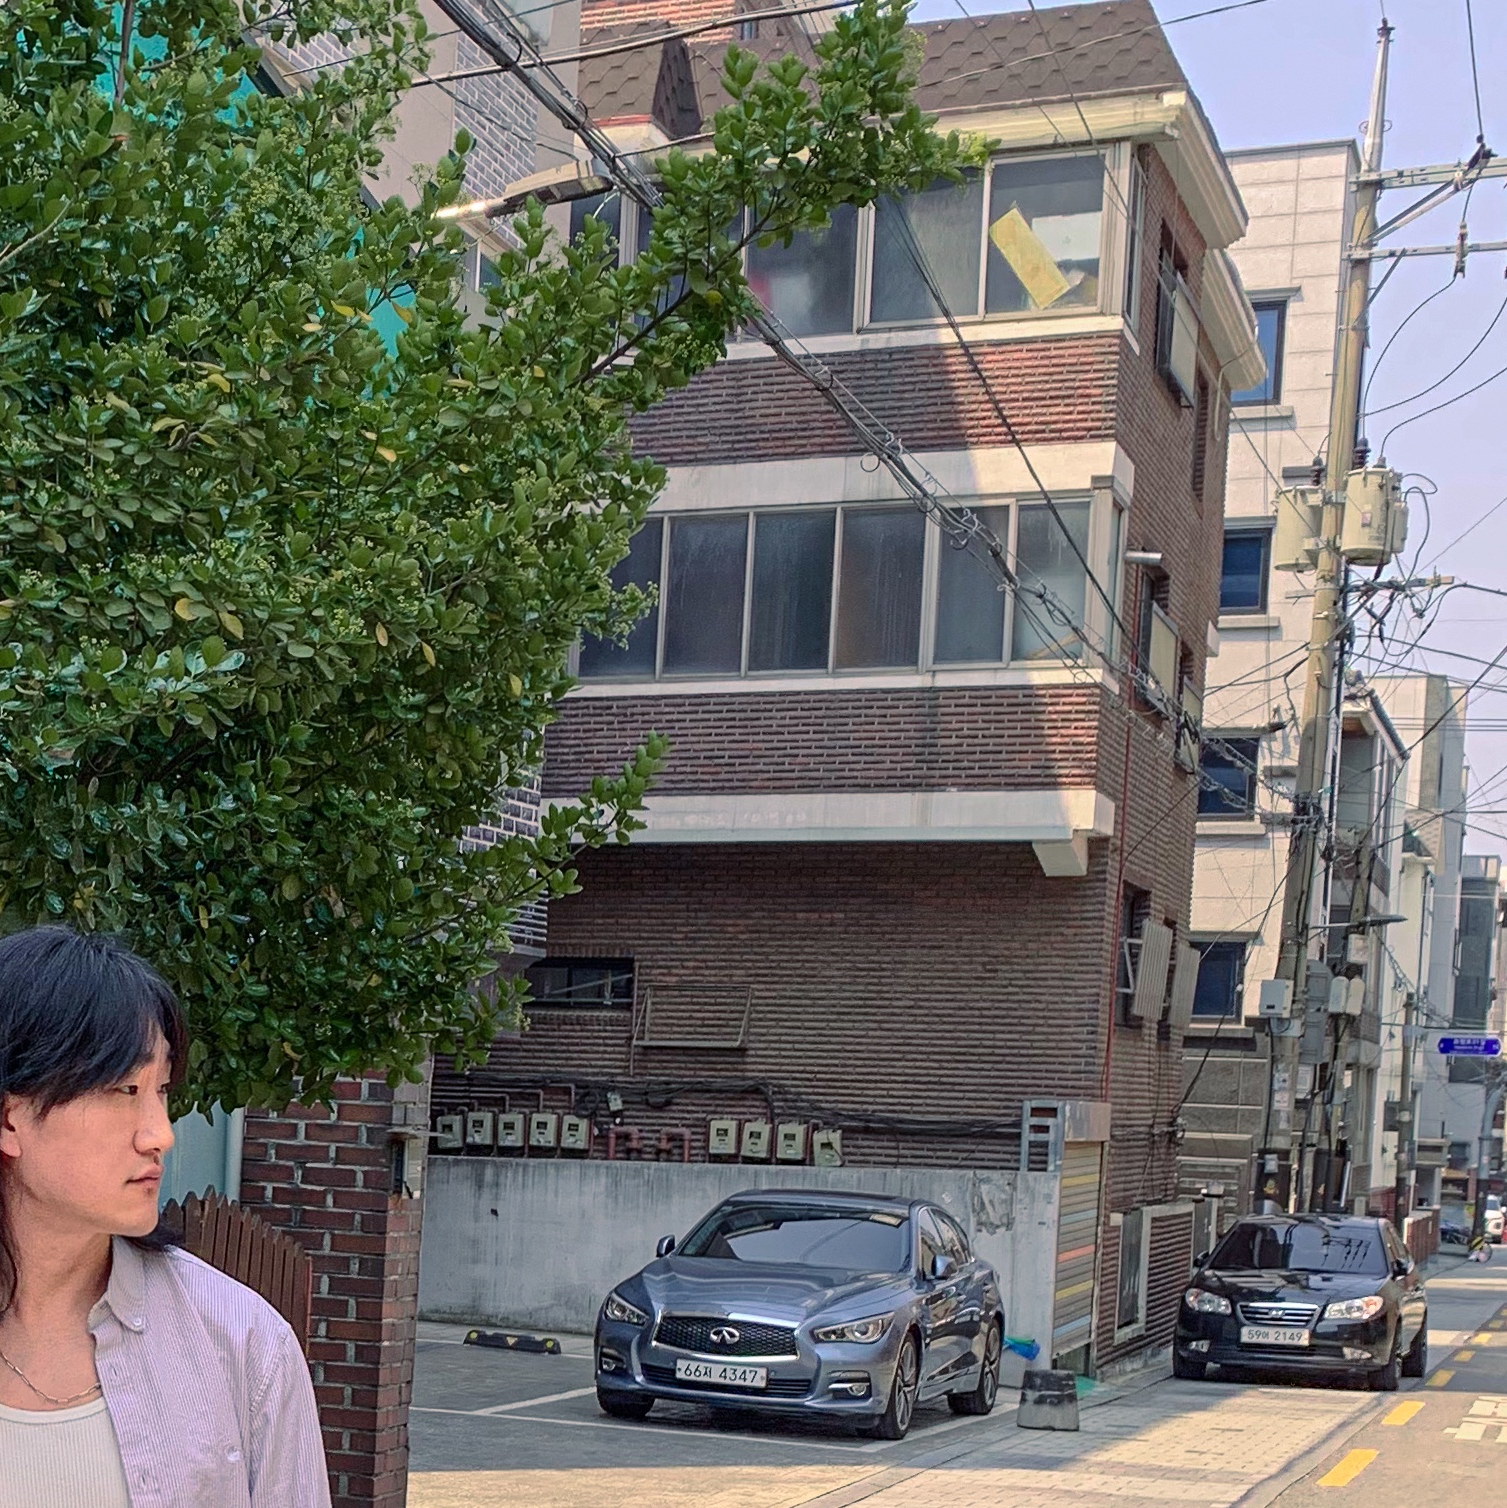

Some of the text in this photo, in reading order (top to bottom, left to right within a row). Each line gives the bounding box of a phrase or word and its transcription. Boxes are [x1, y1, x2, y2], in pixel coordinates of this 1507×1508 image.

[1274, 1330, 1303, 1342] 2149
[684, 1363, 758, 1383] 66저 4347
